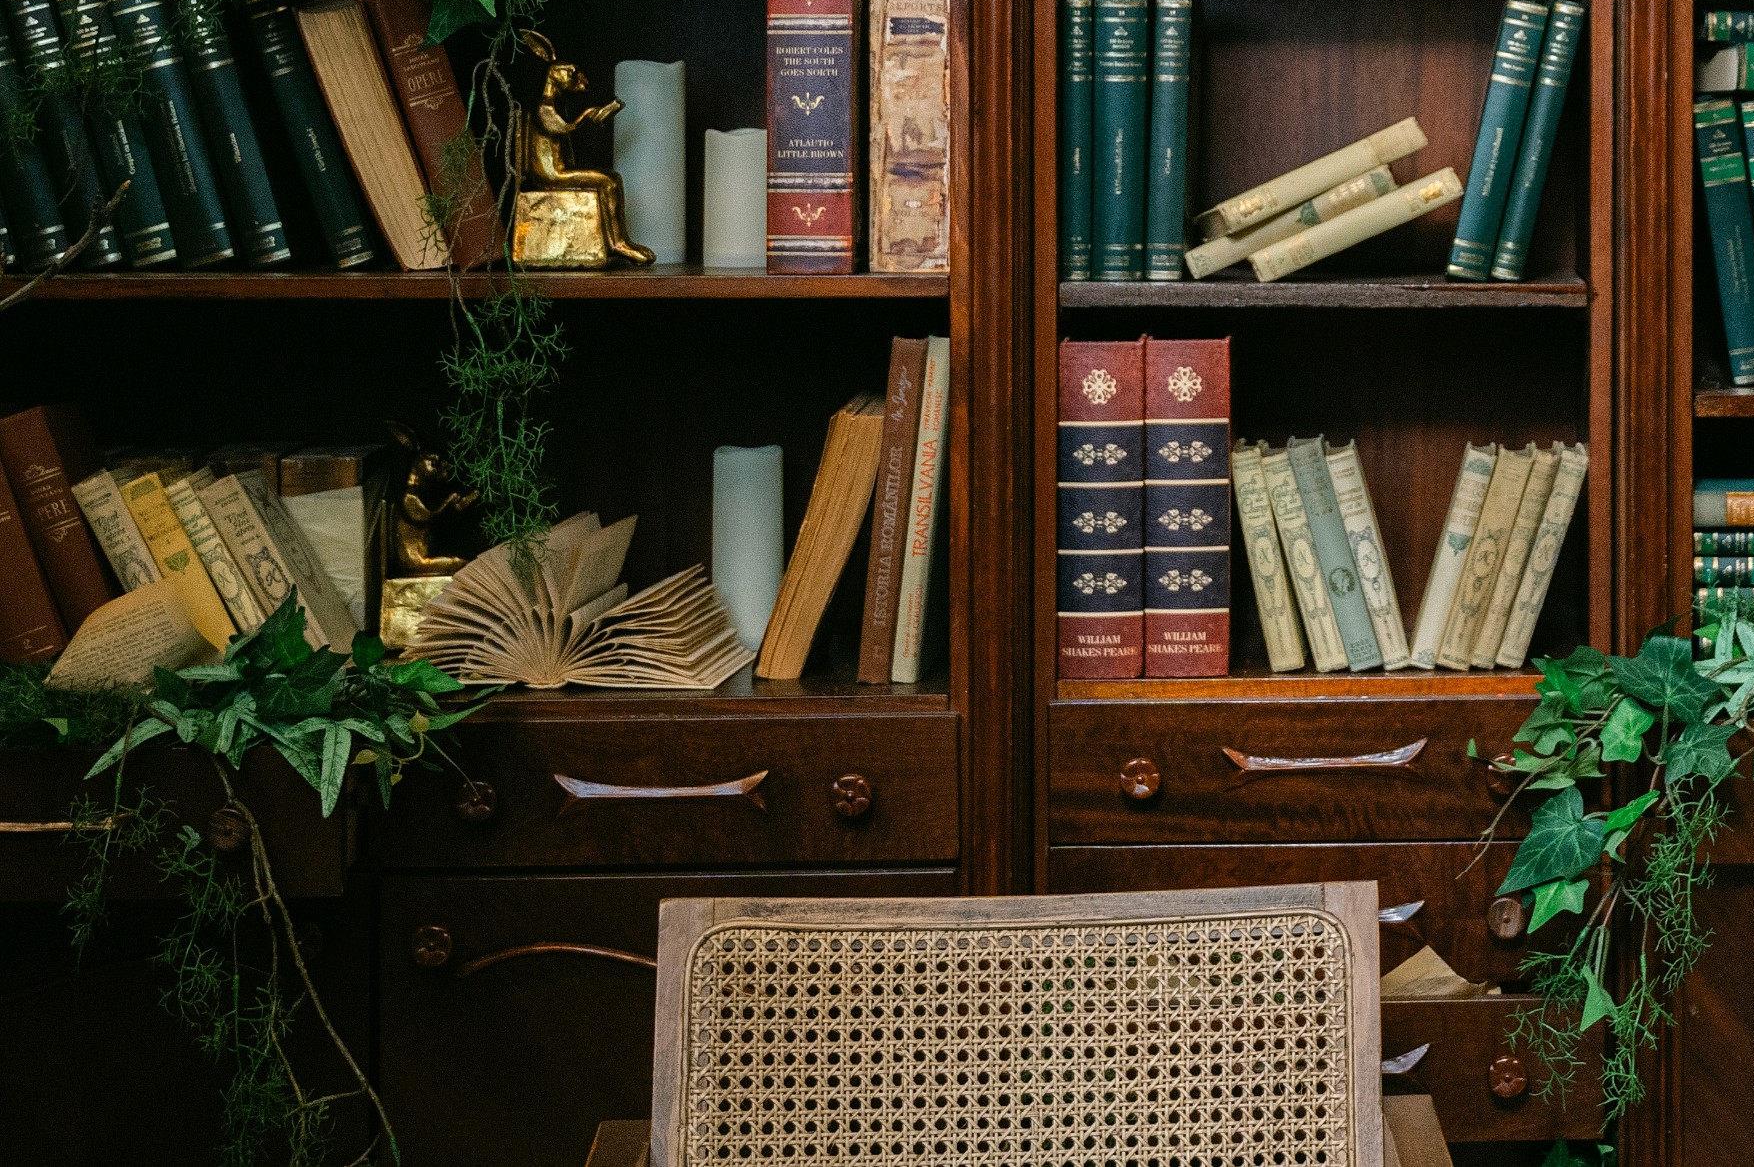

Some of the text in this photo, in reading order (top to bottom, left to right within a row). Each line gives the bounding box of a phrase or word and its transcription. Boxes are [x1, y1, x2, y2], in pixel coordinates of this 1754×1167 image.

[776, 46, 844, 55] ROBERT COLES
[784, 57, 835, 66] THE SOUTH
[780, 67, 838, 77] GOES NORTH
[406, 71, 447, 92] OPERE
[912, 438, 938, 558] TRANSILVANIA
[873, 446, 904, 626] ISTORIA ROMÂNILOR
[1077, 634, 1121, 645] WILLIAM
[1163, 631, 1207, 642] WILLIAM
